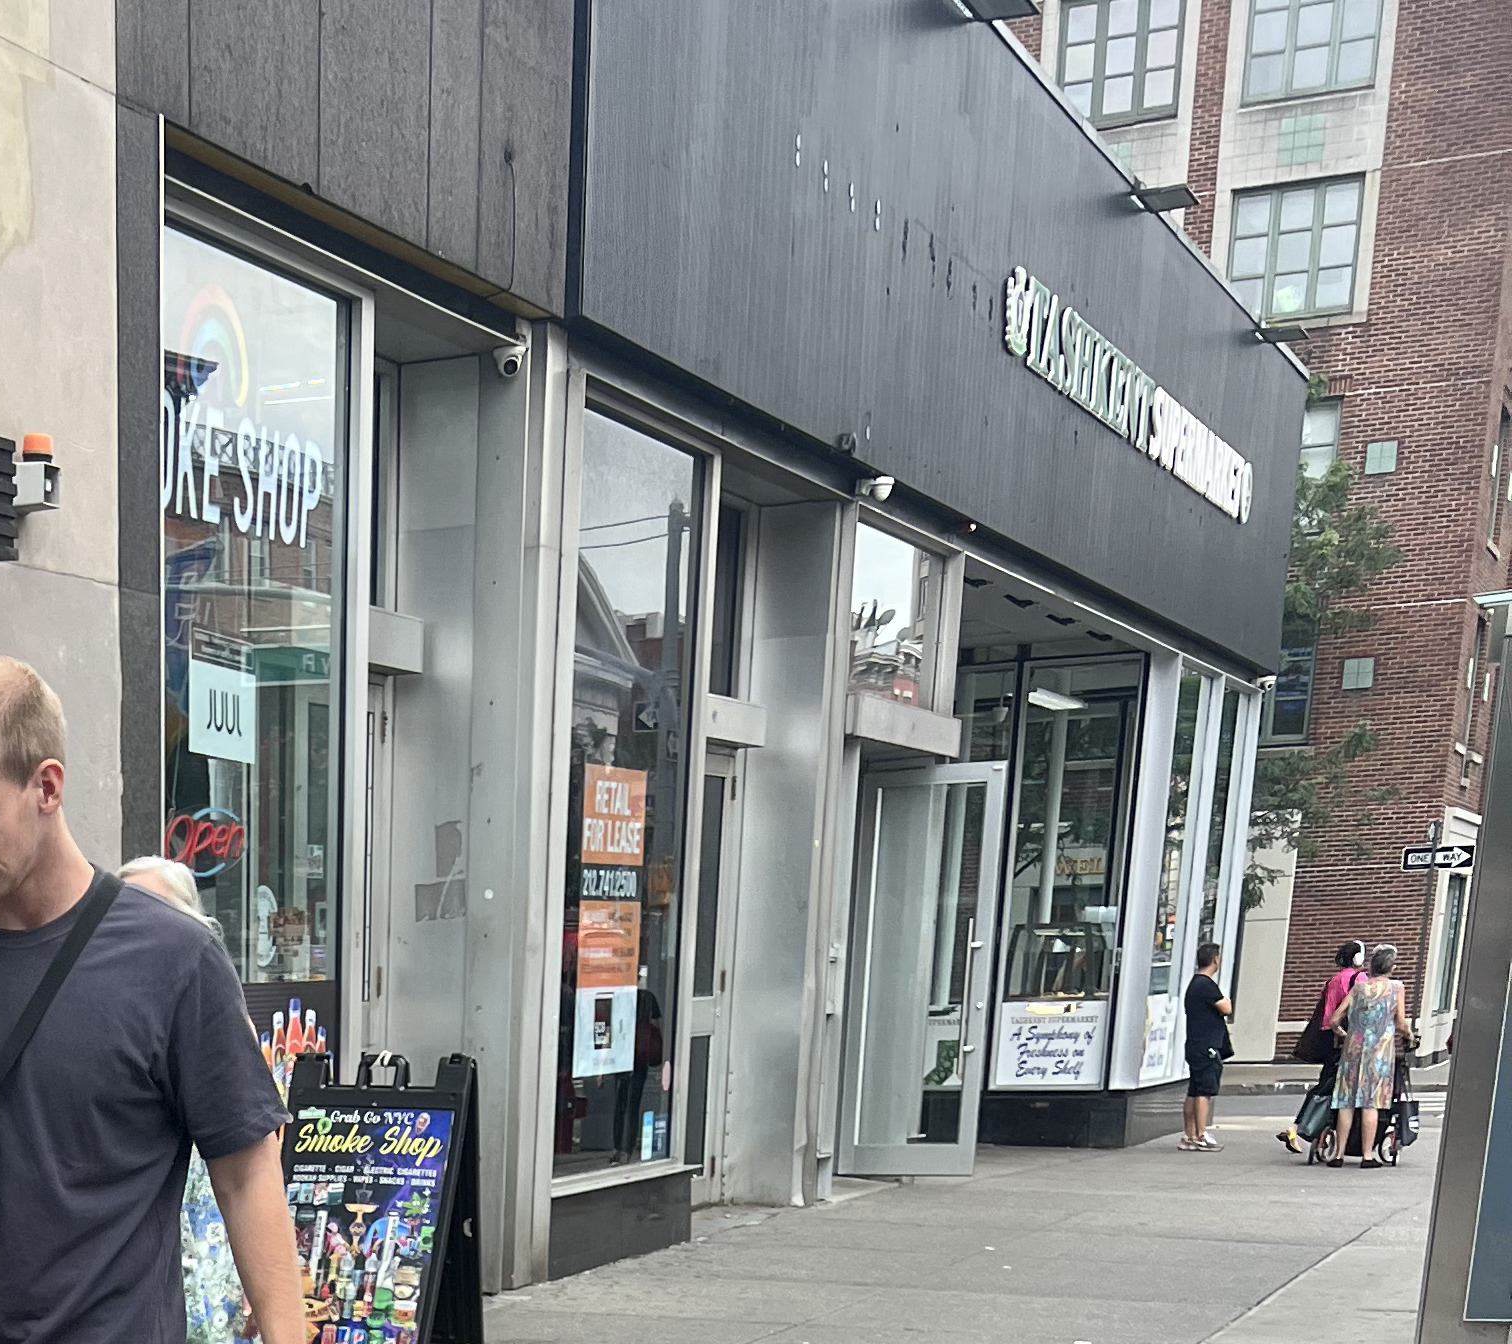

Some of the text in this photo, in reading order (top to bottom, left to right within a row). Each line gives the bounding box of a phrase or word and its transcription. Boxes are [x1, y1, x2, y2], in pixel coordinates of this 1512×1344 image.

[1026, 275, 1246, 519] TASHKENT SUPERMARKET
[233, 416, 323, 549] SHOP
[206, 688, 242, 737] JUUL
[594, 780, 632, 817] RETAIL
[165, 814, 245, 866] Open
[582, 818, 642, 854] FOR LEASE
[1410, 852, 1463, 863] ONE WAY
[1010, 1025, 1097, 1045] A Symphony of
[1016, 1041, 1085, 1061] Freshness on
[1015, 1059, 1084, 1081] Every Shelf
[330, 1109, 361, 1124] Grab
[363, 1110, 381, 1125] Go
[383, 1111, 416, 1125] NYC
[294, 1123, 444, 1167] Smoke Shop
